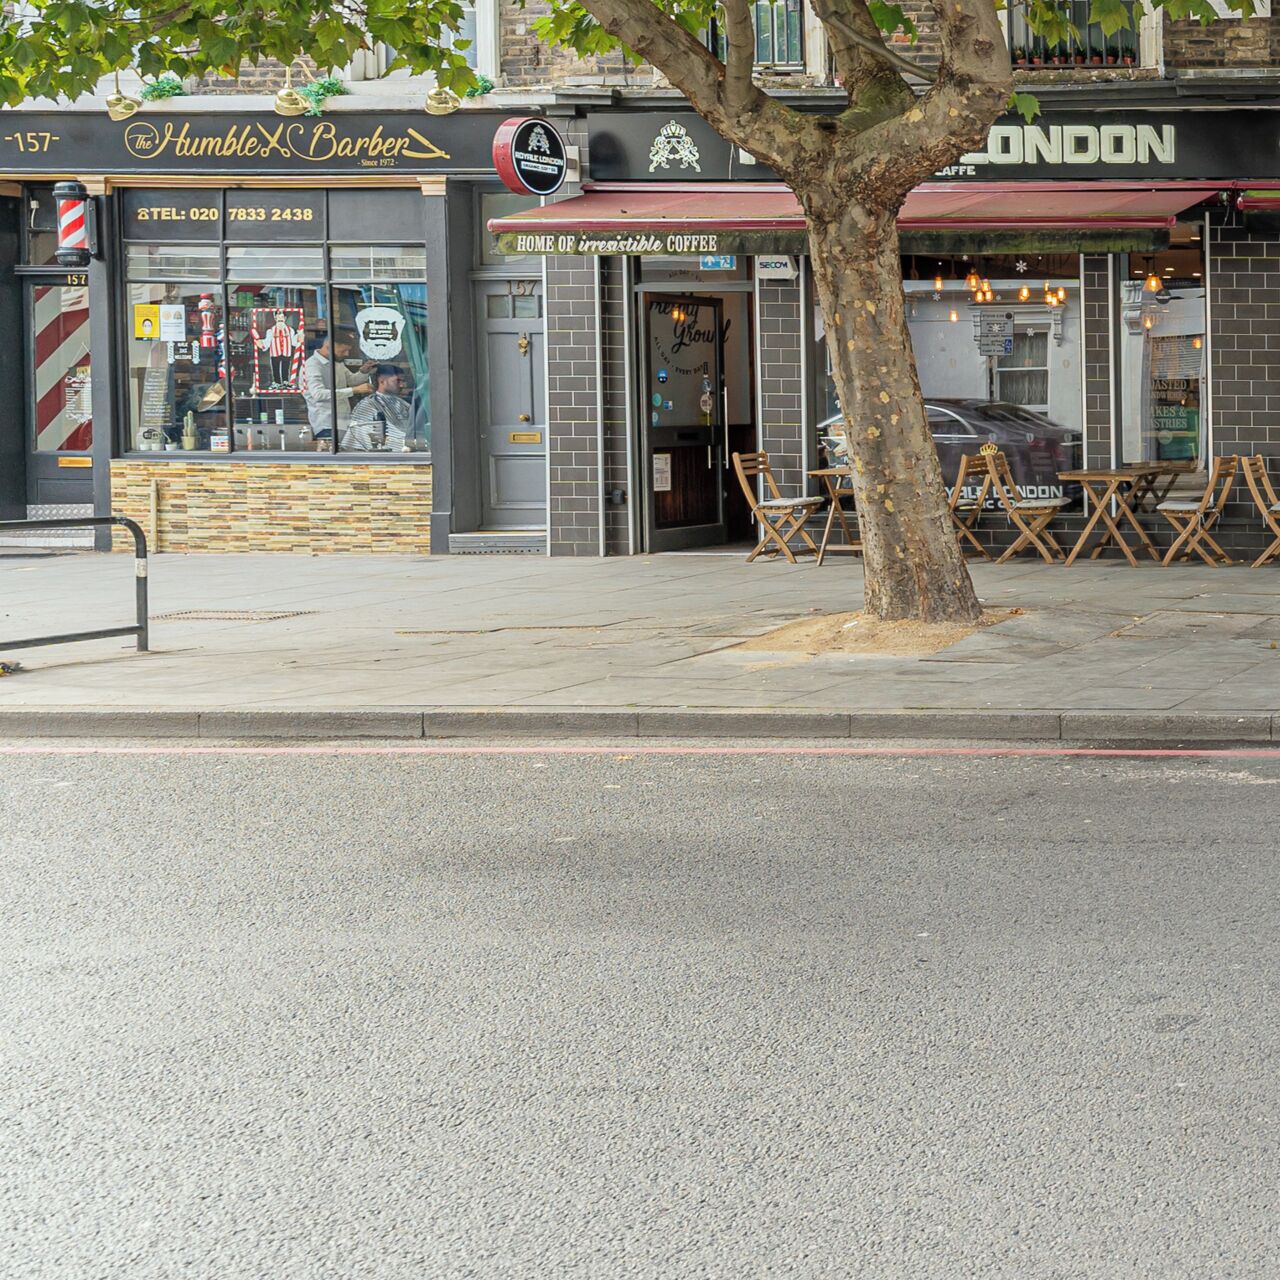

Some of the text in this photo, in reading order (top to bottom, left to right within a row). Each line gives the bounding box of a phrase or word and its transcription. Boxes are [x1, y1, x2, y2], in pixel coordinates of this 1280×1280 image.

[129, 121, 409, 160] The Humble Barber
[360, 158, 395, 167] Since 1972
[935, 165, 976, 176] AFFE
[150, 207, 312, 220] TEL: 020 7833 2438
[517, 235, 717, 252] HOME OF irresistible COFFEE
[759, 261, 788, 269] SECOM
[67, 275, 86, 285] 157
[506, 281, 537, 296] 157
[671, 319, 731, 354] Groud
[1150, 406, 1176, 417] AKES
